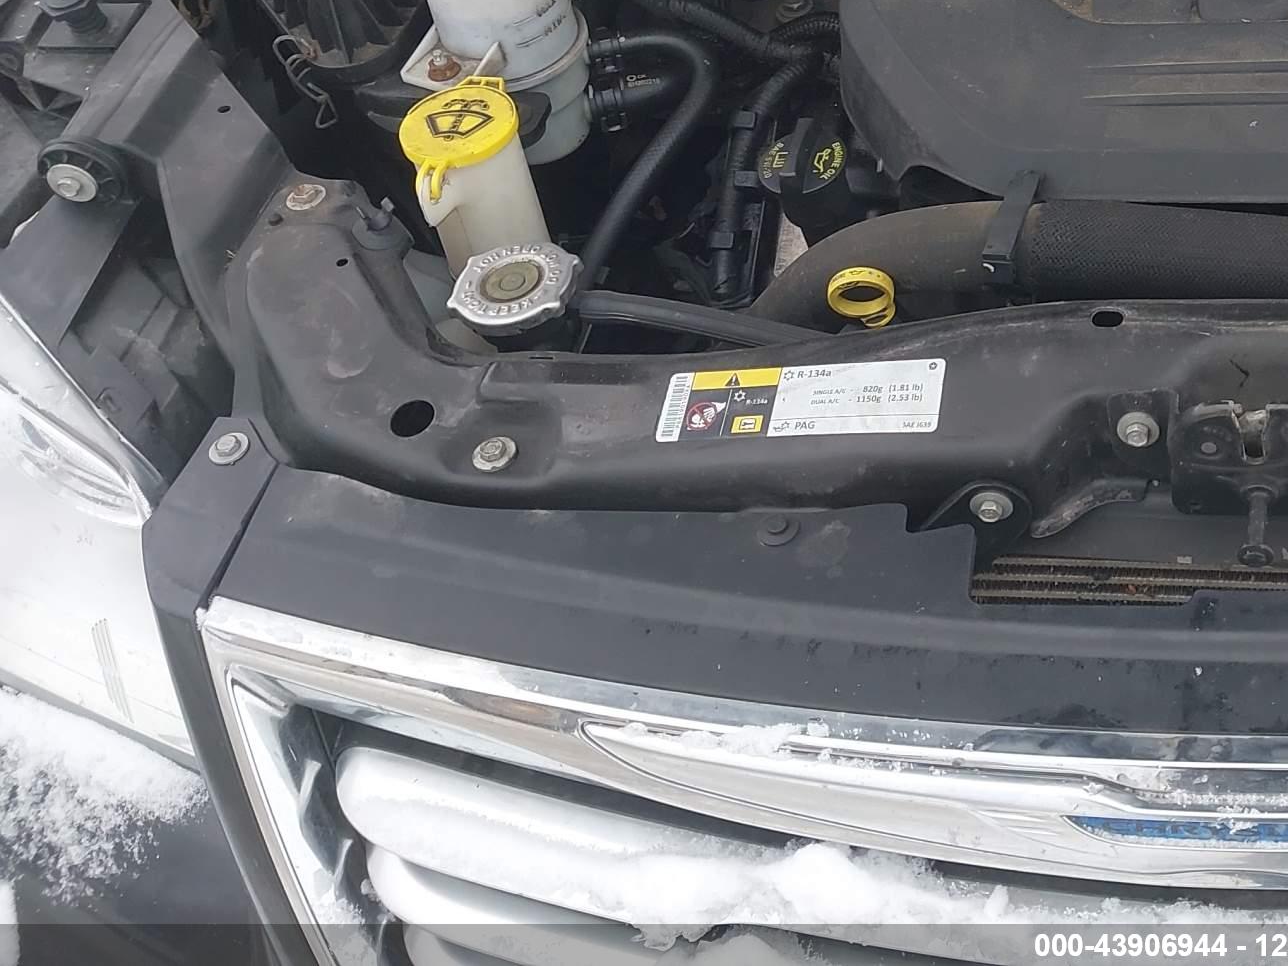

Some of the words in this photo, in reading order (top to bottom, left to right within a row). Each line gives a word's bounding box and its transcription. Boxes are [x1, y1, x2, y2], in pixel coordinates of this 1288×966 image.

[830, 141, 844, 168] ENGINE
[819, 168, 836, 180] OIL
[472, 250, 501, 274] HOT
[488, 297, 534, 316] KEEP
[796, 369, 832, 378] R-134a
[862, 385, 884, 394] 820g
[888, 384, 910, 394] (1.81
[911, 383, 924, 392] lb)
[856, 395, 882, 404] 1150g
[888, 394, 909, 403] (2.53
[911, 393, 922, 402] lb)
[794, 421, 816, 430] PAG
